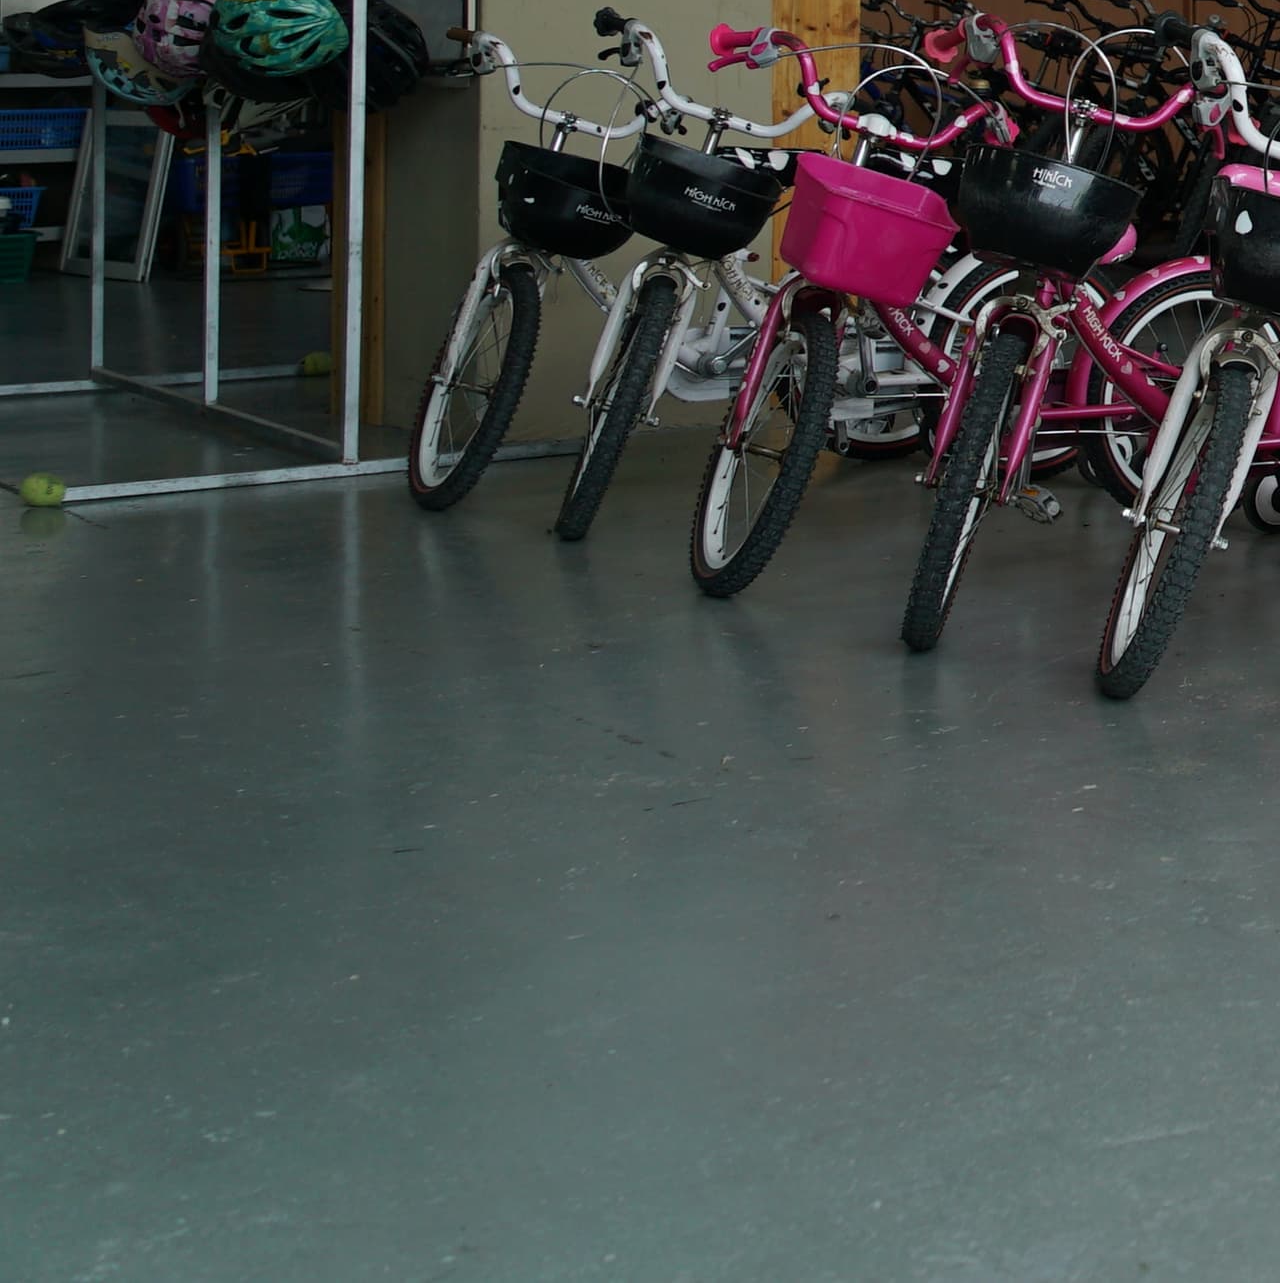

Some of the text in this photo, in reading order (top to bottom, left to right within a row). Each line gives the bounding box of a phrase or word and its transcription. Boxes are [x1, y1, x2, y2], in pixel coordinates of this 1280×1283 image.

[576, 204, 603, 217] HIGH
[684, 185, 737, 213] HIGH KICK
[1083, 305, 1123, 363] HIGH KICK
